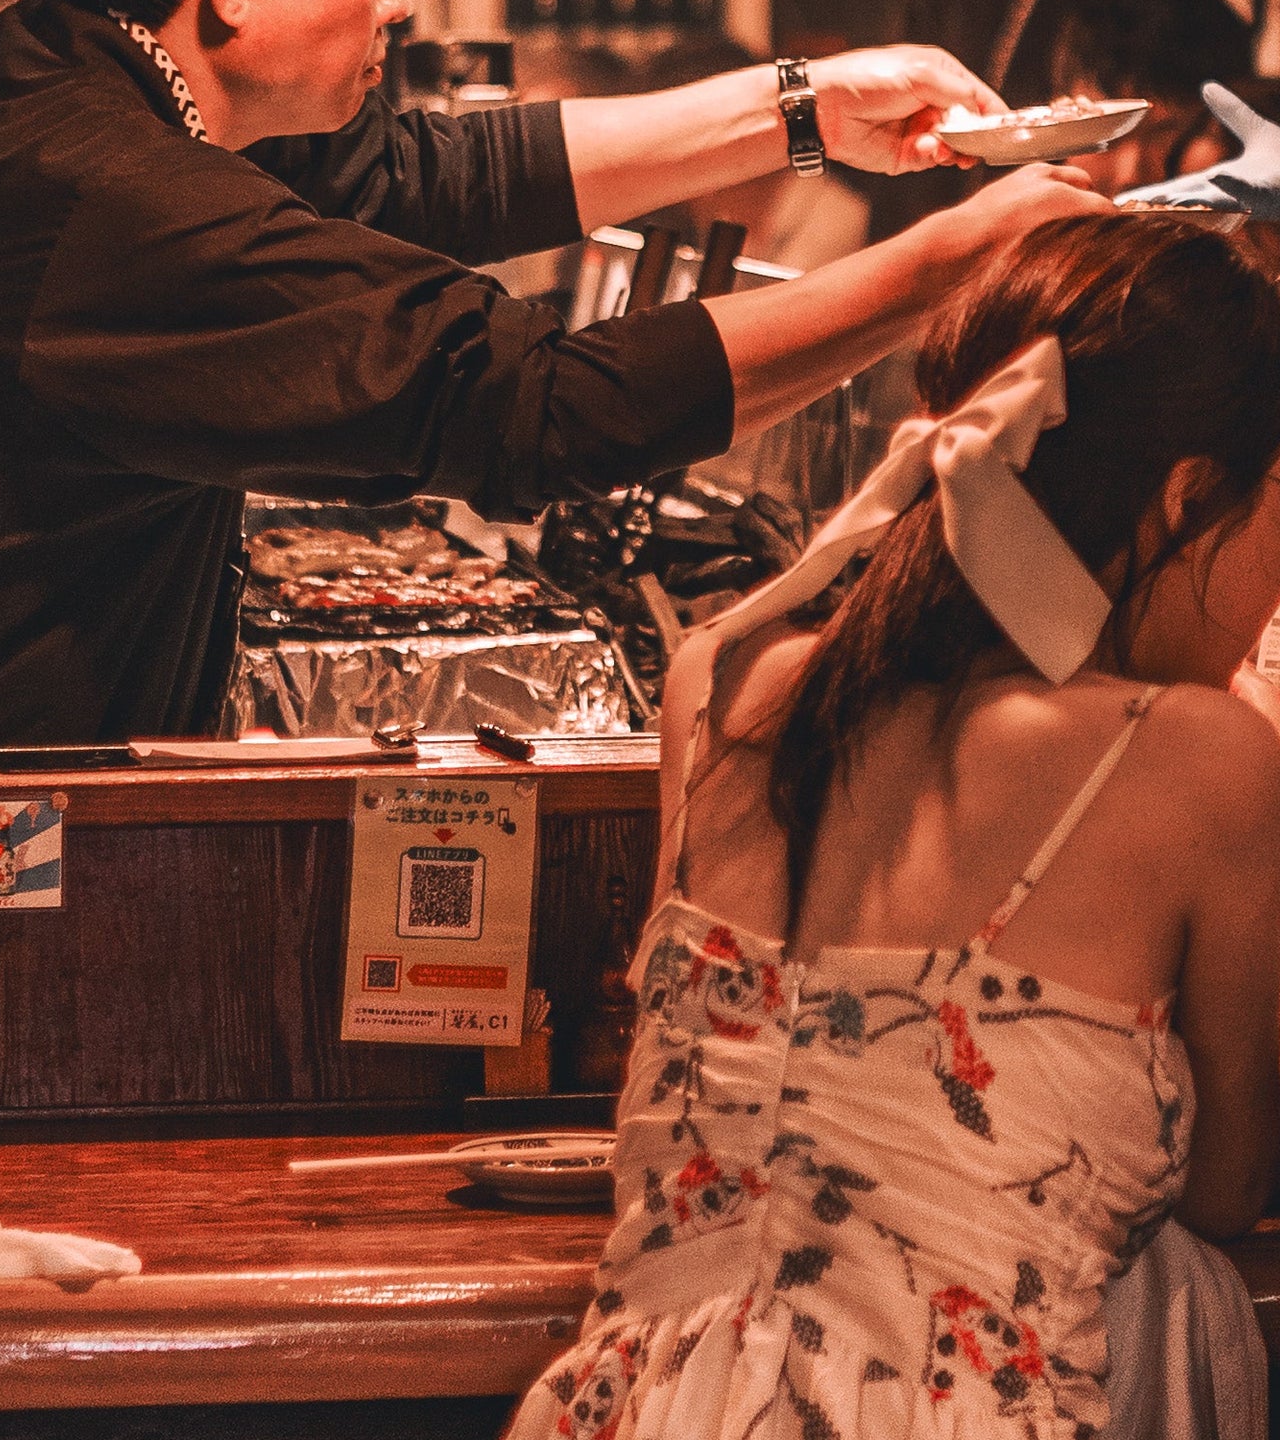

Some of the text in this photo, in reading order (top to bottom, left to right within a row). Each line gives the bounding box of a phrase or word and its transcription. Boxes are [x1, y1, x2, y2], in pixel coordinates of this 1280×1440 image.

[395, 787, 490, 805] スマホからの
[386, 806, 495, 825] ご注文はコチラ
[416, 849, 469, 860] LINEアプリ
[488, 1014, 508, 1030] C1
